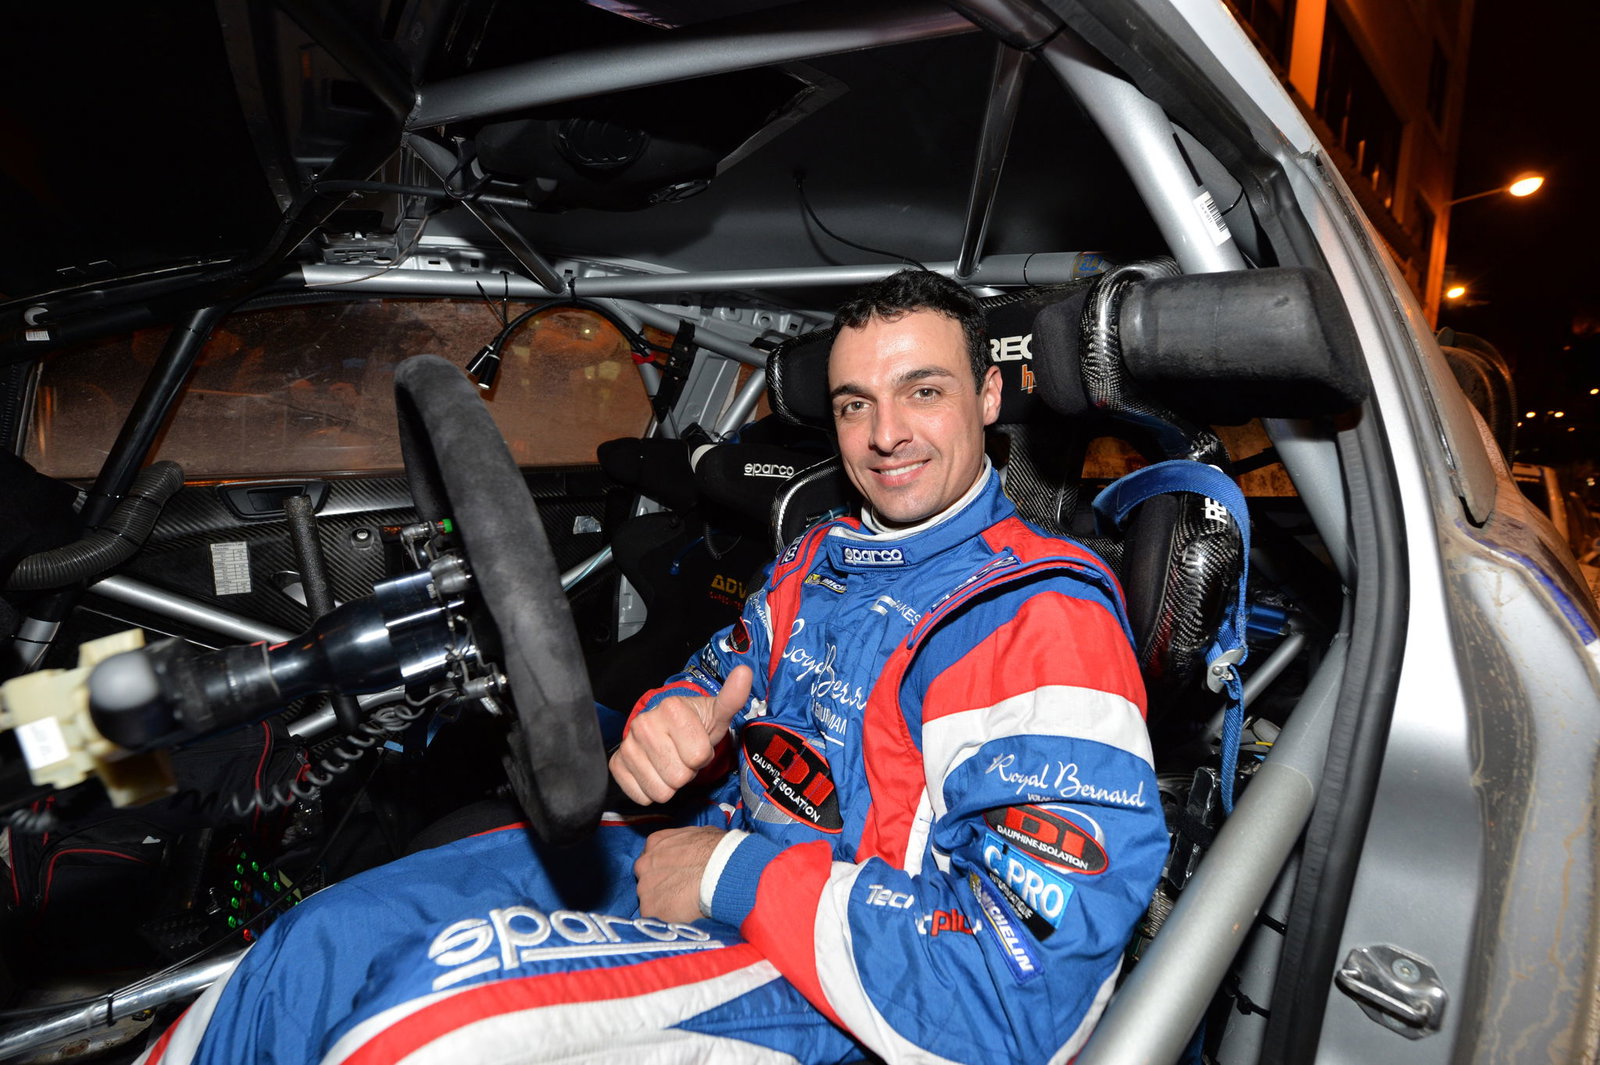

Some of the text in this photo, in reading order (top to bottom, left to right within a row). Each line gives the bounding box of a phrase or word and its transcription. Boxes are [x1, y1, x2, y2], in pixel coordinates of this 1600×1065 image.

[743, 462, 795, 479] sparco
[844, 547, 903, 563] sparco
[778, 782, 821, 823] ISOLATION
[985, 752, 1147, 808] Royal Bernard
[1004, 807, 1086, 858] DI
[427, 905, 711, 971] sparco
[979, 890, 1035, 973] MICHELIN
